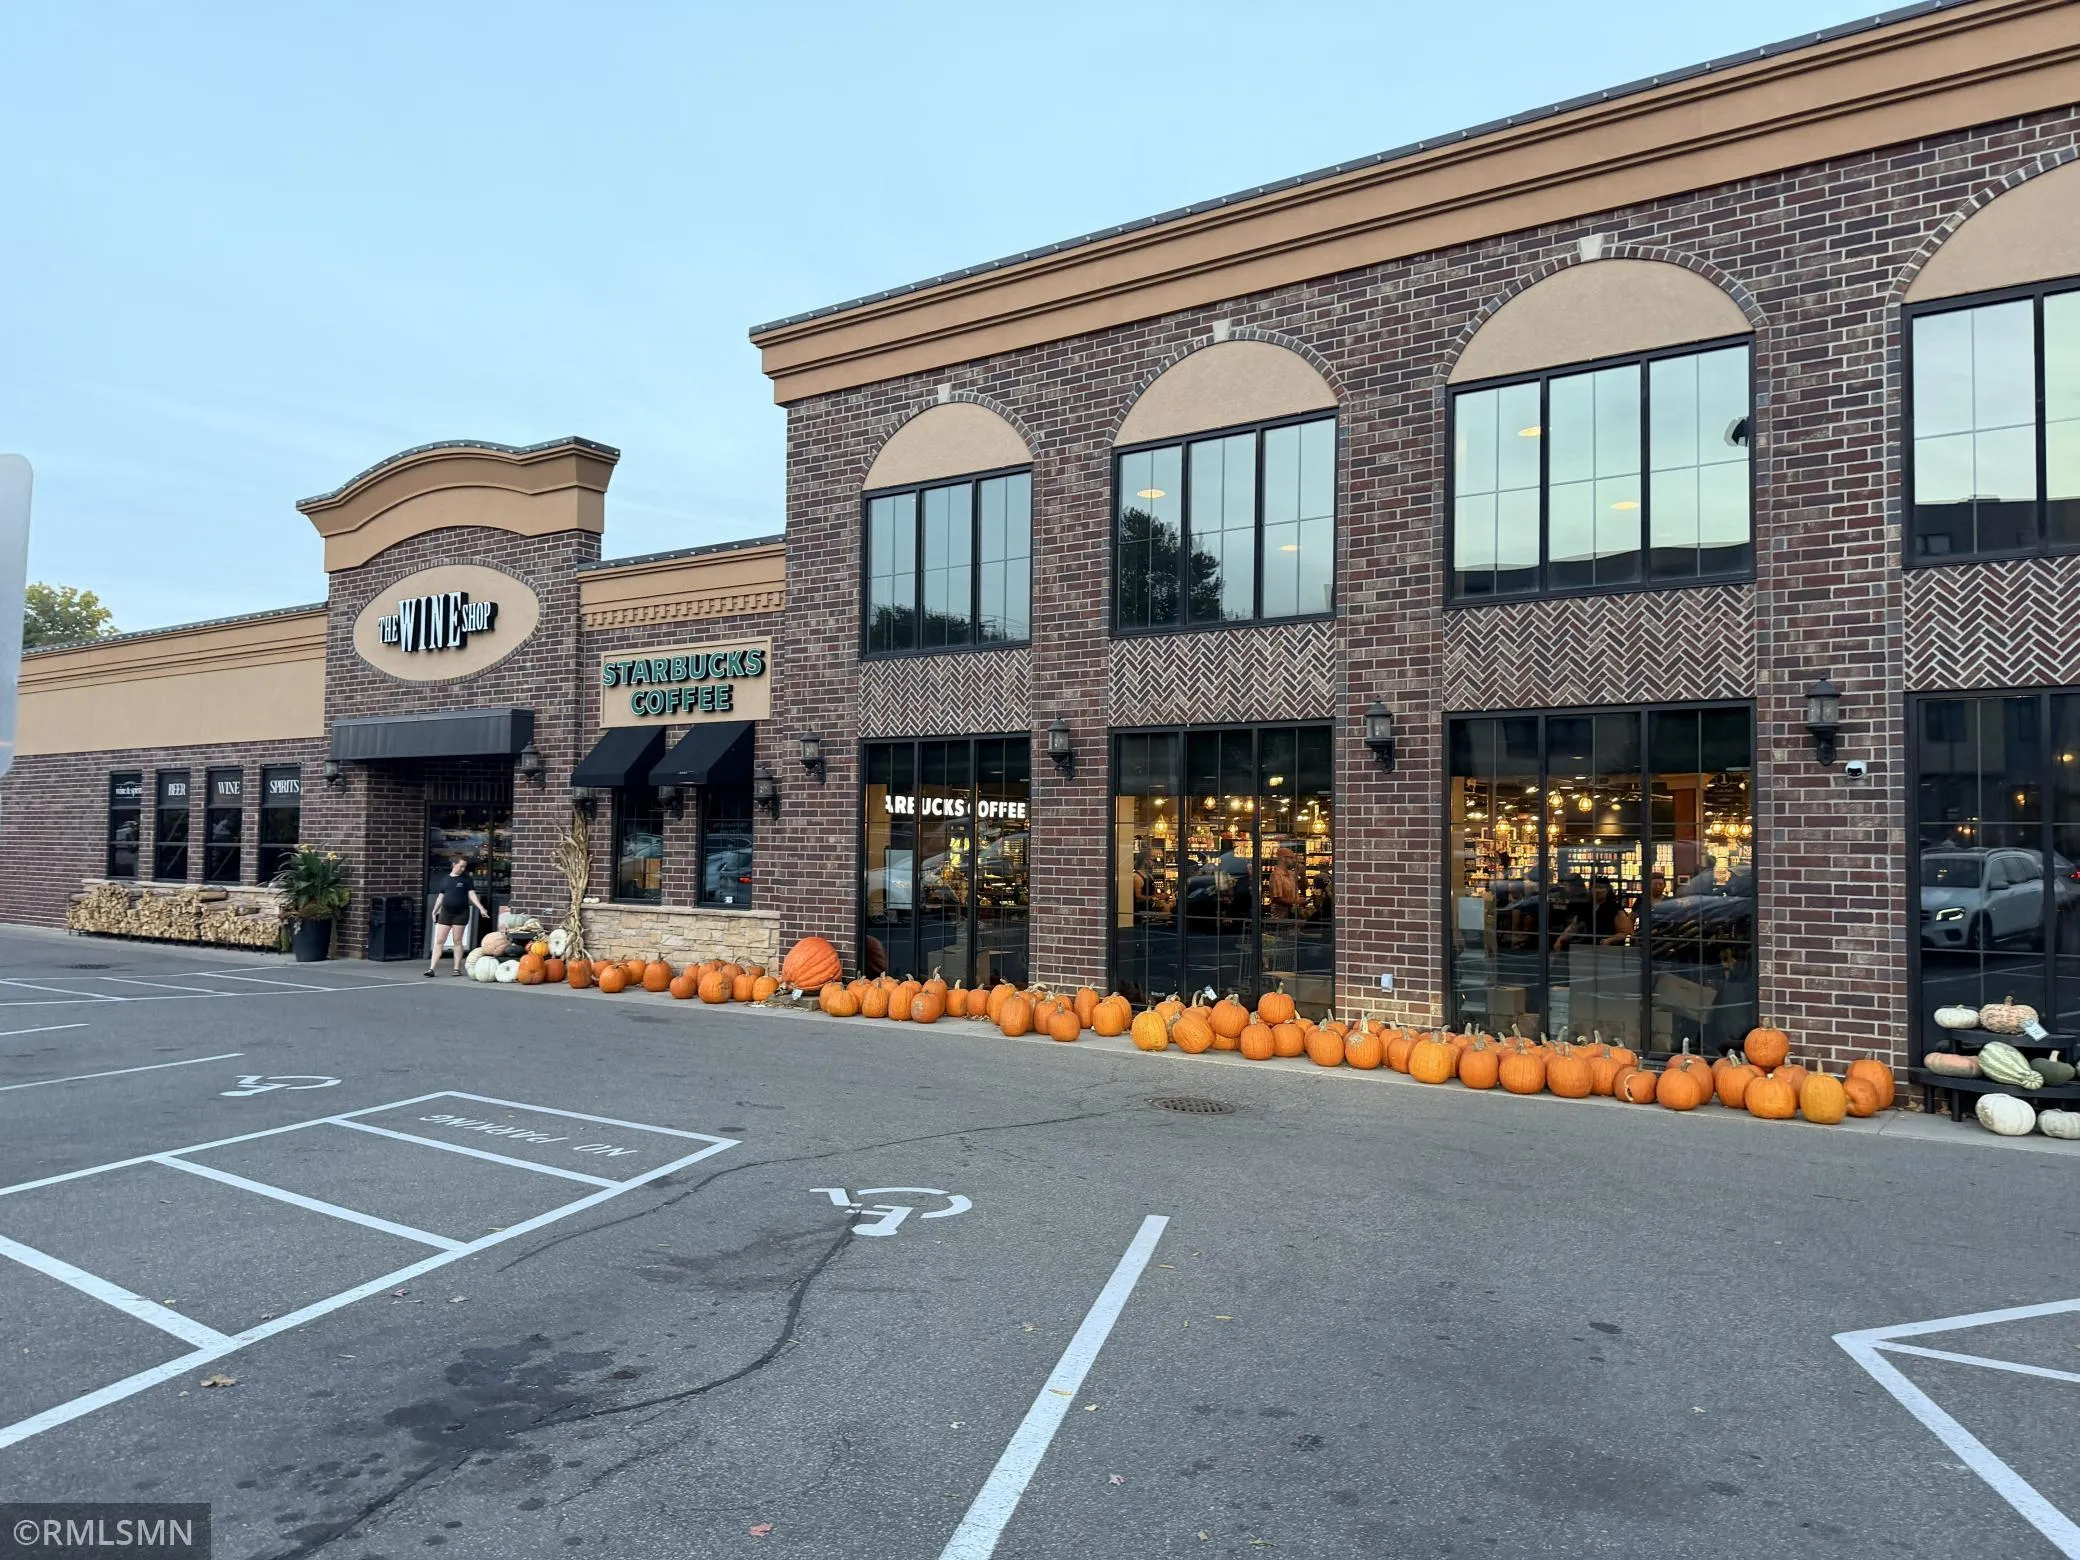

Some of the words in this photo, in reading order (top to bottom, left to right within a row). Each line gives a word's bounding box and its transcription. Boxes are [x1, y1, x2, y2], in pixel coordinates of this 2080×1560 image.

[378, 615, 398, 643] THE
[398, 592, 462, 651] WINE
[461, 601, 492, 632] SHOP
[603, 648, 763, 686] STARBUCKS
[630, 684, 731, 715] COFFEE
[168, 783, 186, 796] BEER
[217, 781, 241, 795] WINE
[269, 779, 300, 794] SPIRITS
[968, 801, 1026, 818] OFFEE
[419, 1114, 569, 1143] PARKING
[573, 1143, 638, 1157] NO
